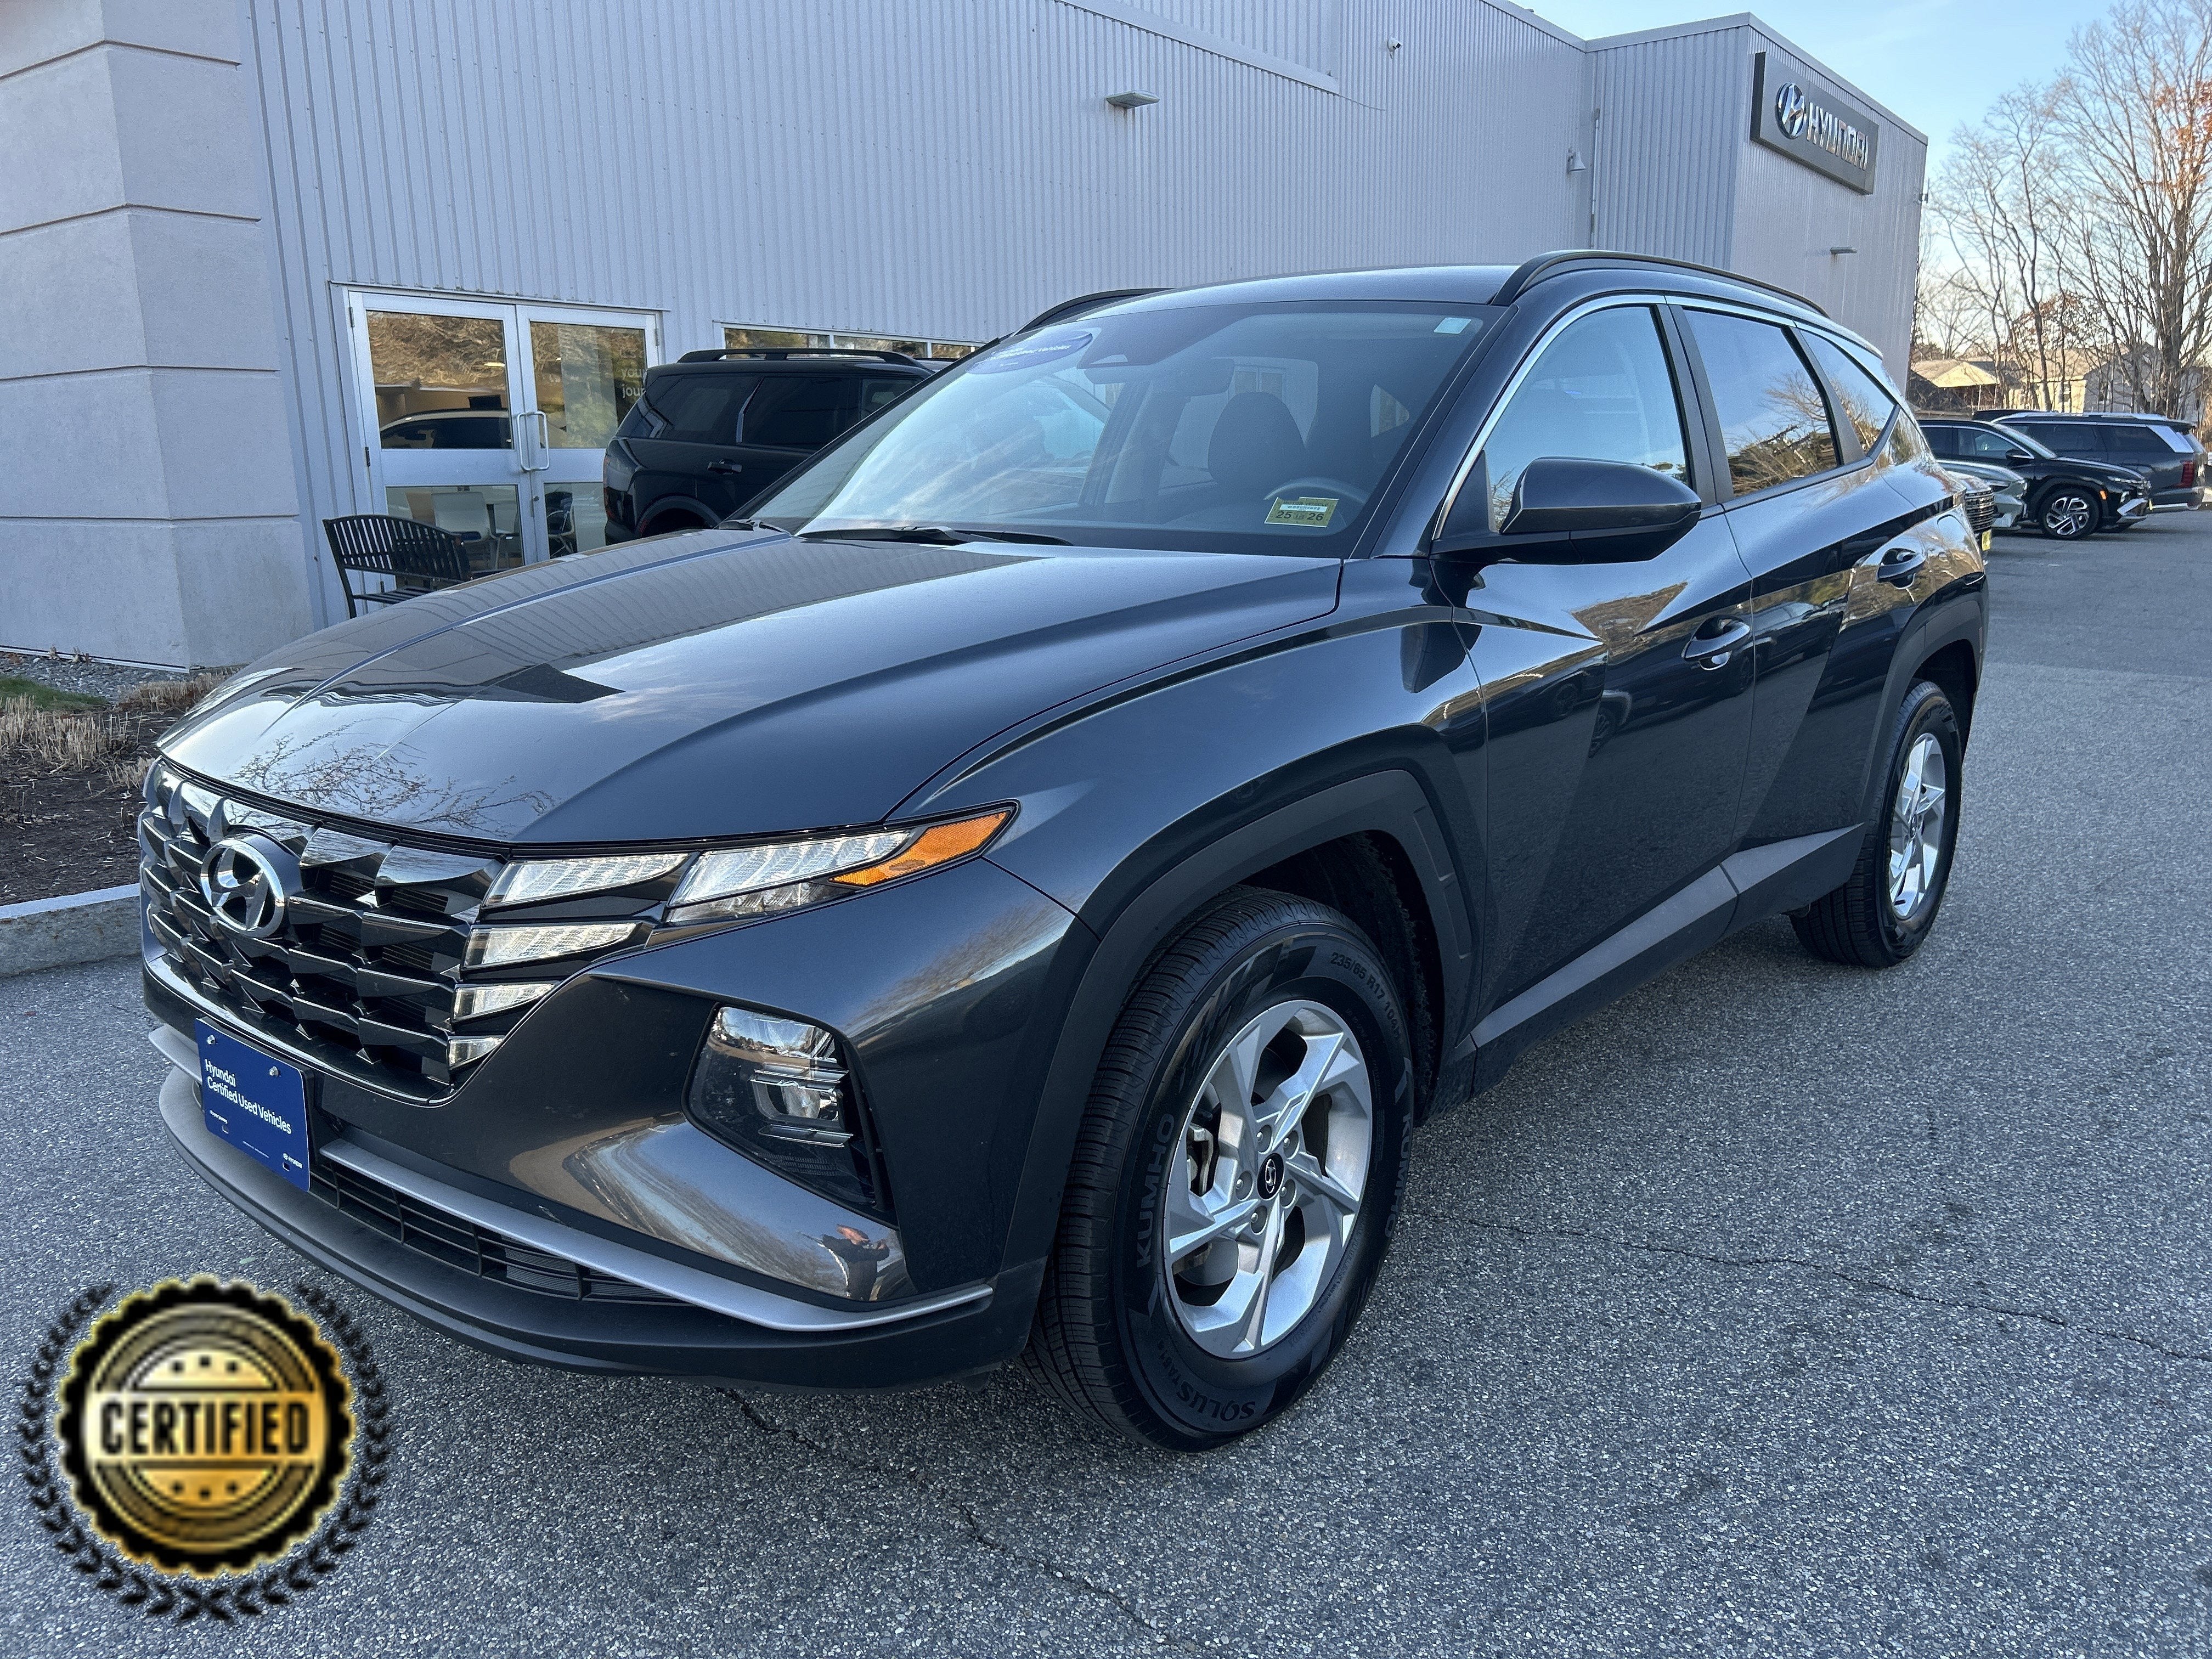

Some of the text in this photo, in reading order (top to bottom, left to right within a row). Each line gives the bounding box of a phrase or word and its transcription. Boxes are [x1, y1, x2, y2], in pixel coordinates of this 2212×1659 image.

[1807, 102, 1869, 171] HYUNDAI
[1275, 511, 1324, 521] 25 26
[1330, 952, 1367, 979] 235/65
[1366, 974, 1386, 1000] R17
[205, 1058, 236, 1087] Hyundai
[207, 1076, 239, 1104] Certified
[238, 1093, 258, 1116] Used
[257, 1104, 292, 1135] Vehicles
[1136, 1113, 1175, 1268] KUMHO
[1176, 1381, 1256, 1421] SOLUS
